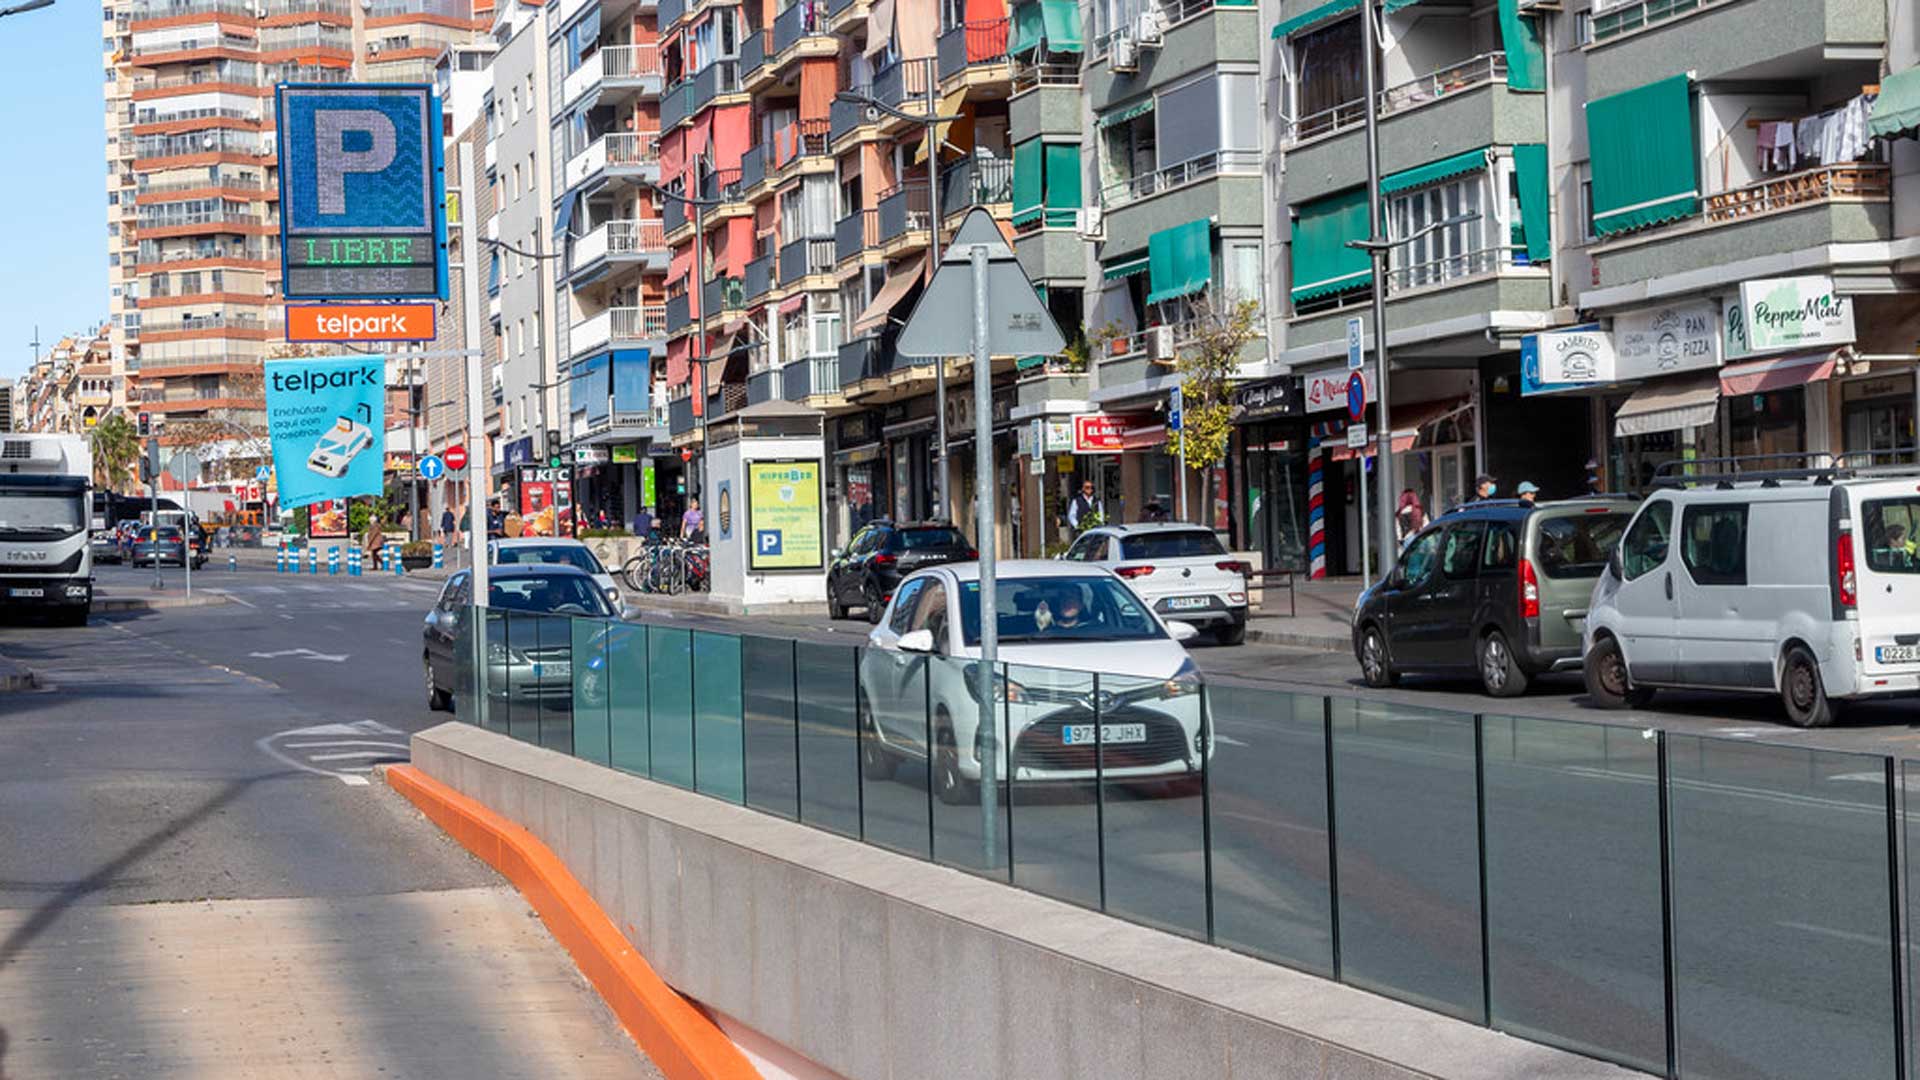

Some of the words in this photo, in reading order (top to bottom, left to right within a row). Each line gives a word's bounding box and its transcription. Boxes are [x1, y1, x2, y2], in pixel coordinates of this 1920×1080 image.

[314, 108, 398, 215] P
[306, 237, 413, 264] LIBRE
[316, 313, 407, 338] telpark
[1685, 316, 1706, 334] PAN
[1683, 340, 1710, 357] PIZZA
[272, 367, 377, 394] telpark
[1087, 426, 1099, 436] EL
[762, 534, 778, 551] P
[1883, 647, 1913, 659] 0228
[1073, 727, 1111, 741] 972
[1117, 725, 1144, 740] JHX
